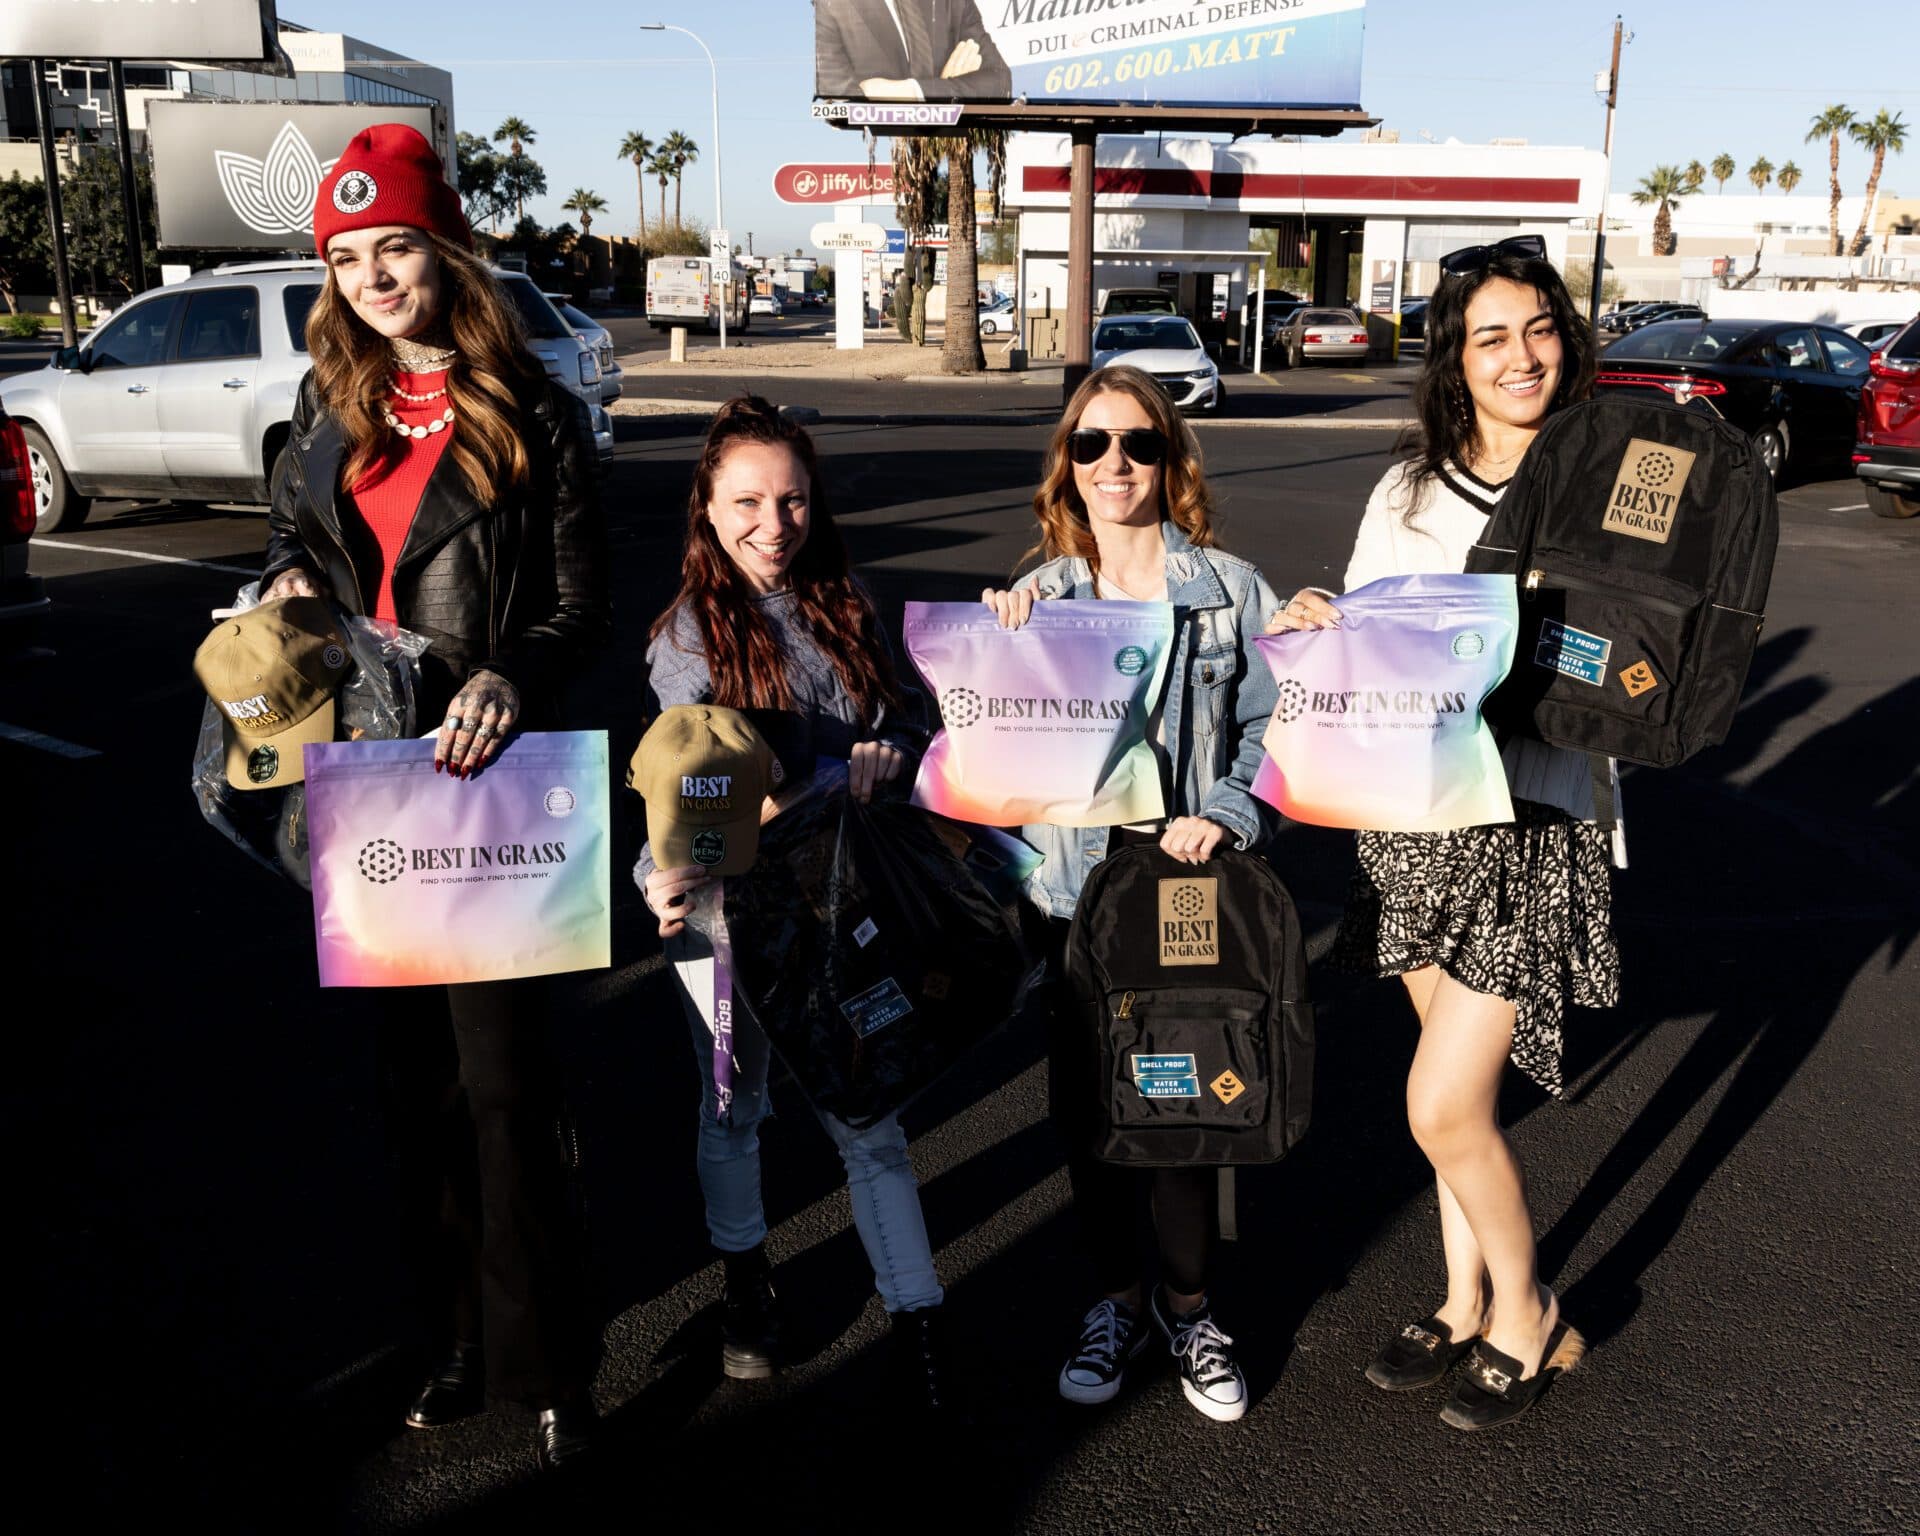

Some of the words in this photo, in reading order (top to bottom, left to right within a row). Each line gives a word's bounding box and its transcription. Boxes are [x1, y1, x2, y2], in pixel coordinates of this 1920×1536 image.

[1028, 34, 1067, 56] DUI
[1091, 11, 1200, 44] CRIMINAL
[1044, 27, 1297, 94] 602.600.MATT
[813, 106, 848, 117] 2048
[852, 106, 957, 122] OUTFRONT
[713, 271, 729, 281] 40
[1613, 484, 1676, 517] BEST
[1609, 508, 1625, 524] IN
[1625, 512, 1668, 534] GRASS
[1550, 628, 1574, 643] SMELL
[1575, 638, 1601, 652] PROOF
[1546, 657, 1591, 678] RESISTANT
[1558, 653, 1584, 667] WATER
[221, 695, 270, 718] BEST
[988, 697, 1037, 719] BEST
[1041, 698, 1063, 719] IN
[1066, 699, 1130, 721] GRASS
[1311, 691, 1361, 714] BEST
[1364, 691, 1389, 714] IN
[1393, 691, 1466, 714] GRASS
[243, 711, 279, 729] GRASS
[681, 775, 732, 798] BEST
[681, 797, 693, 809] IN
[695, 797, 731, 810] GRASS
[412, 847, 465, 871] BEST
[470, 845, 492, 868] IN
[497, 841, 567, 866] GRASS
[694, 847, 722, 858] HEMP
[441, 876, 463, 884] YOUR
[487, 874, 506, 882] FIND
[507, 873, 529, 881] YOUR
[531, 871, 551, 879] WHY.
[1164, 920, 1214, 942] BEST
[1163, 945, 1176, 957] IN
[1178, 944, 1215, 957] GRASS
[719, 999, 733, 1034] GCU
[868, 1006, 890, 1021] WATER
[1146, 1087, 1188, 1095] RESISTANT
